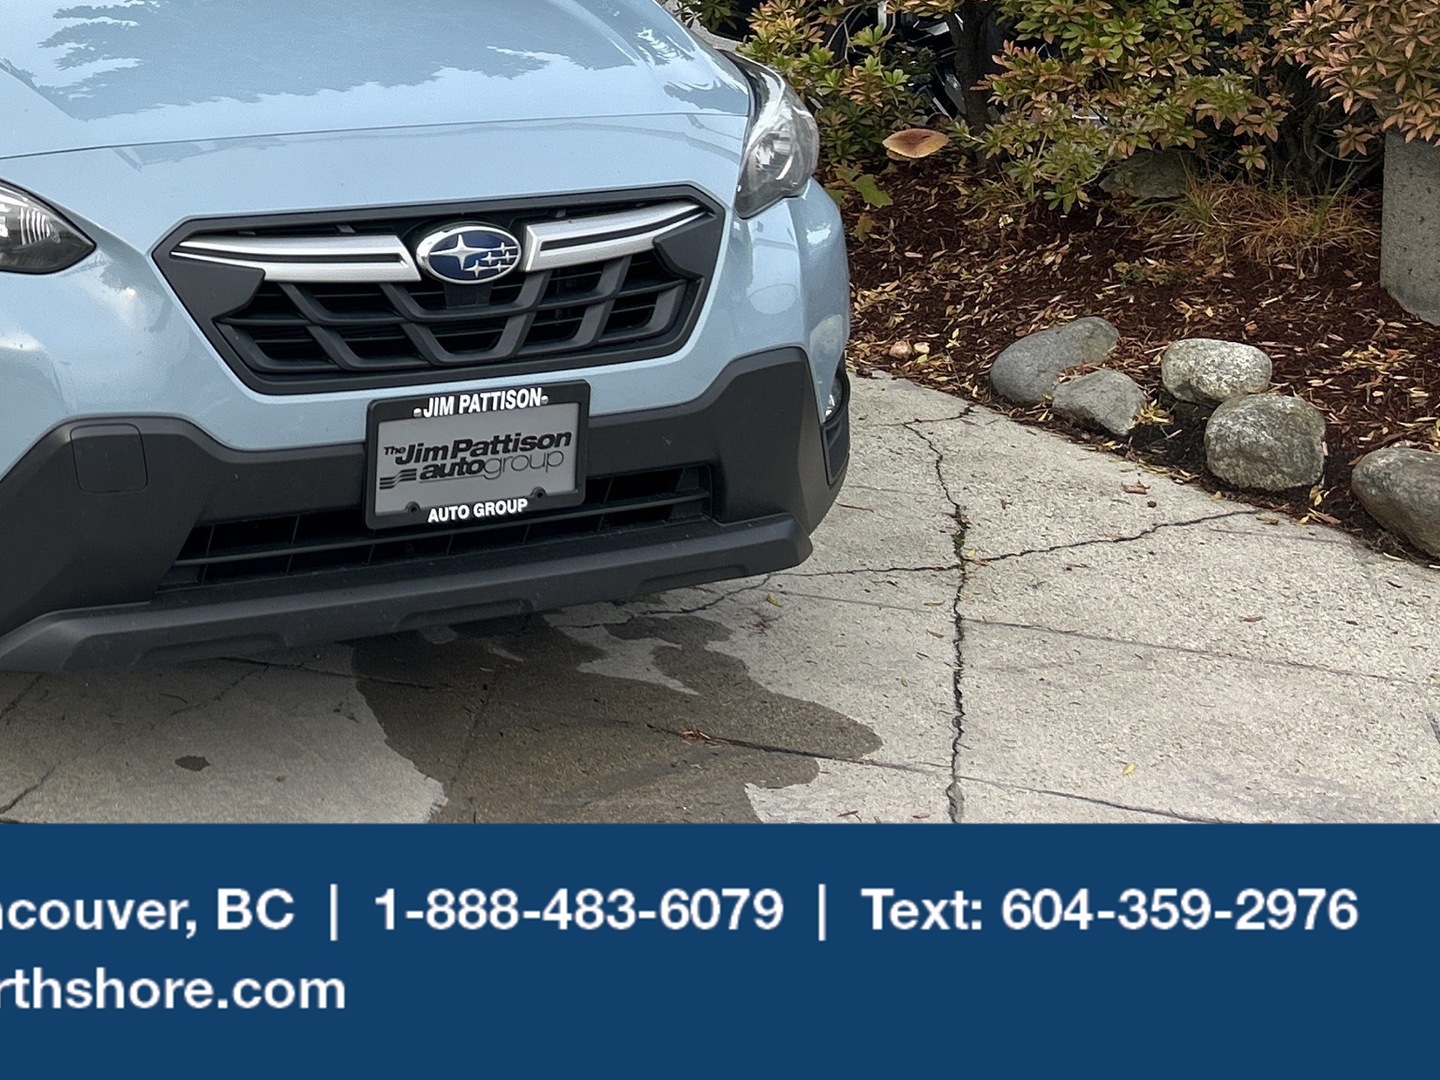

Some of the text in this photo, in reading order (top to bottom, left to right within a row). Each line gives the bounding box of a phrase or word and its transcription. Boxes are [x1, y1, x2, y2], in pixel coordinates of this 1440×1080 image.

[423, 387, 542, 418] JIM PATTISON
[384, 446, 406, 456] The
[395, 431, 572, 466] Jim Pattison
[427, 498, 529, 523] AUTO GROUP
